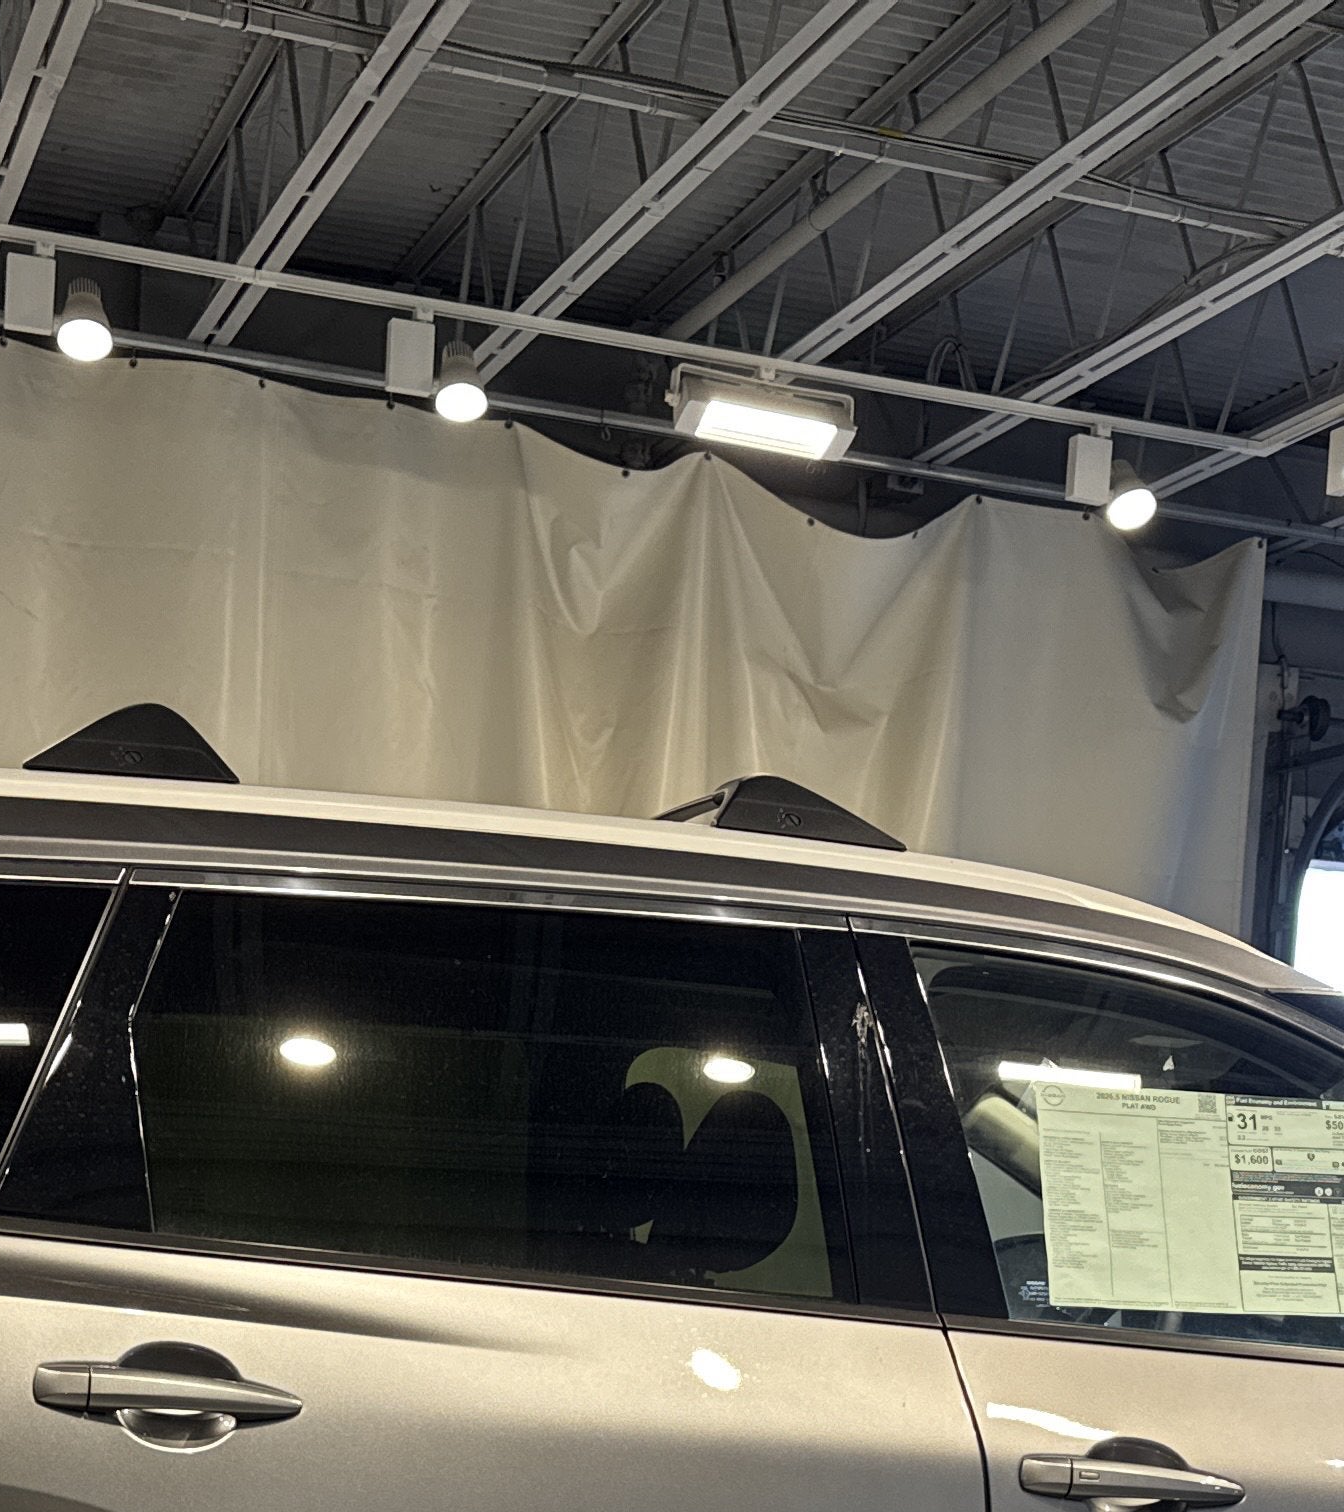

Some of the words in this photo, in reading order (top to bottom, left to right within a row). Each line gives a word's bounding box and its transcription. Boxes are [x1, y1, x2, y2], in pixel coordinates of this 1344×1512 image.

[1121, 1093, 1151, 1102] NISSAN
[1153, 1095, 1181, 1104] ROGUE
[1236, 1113, 1257, 1131] 31
[1234, 1154, 1269, 1165] $1,600
